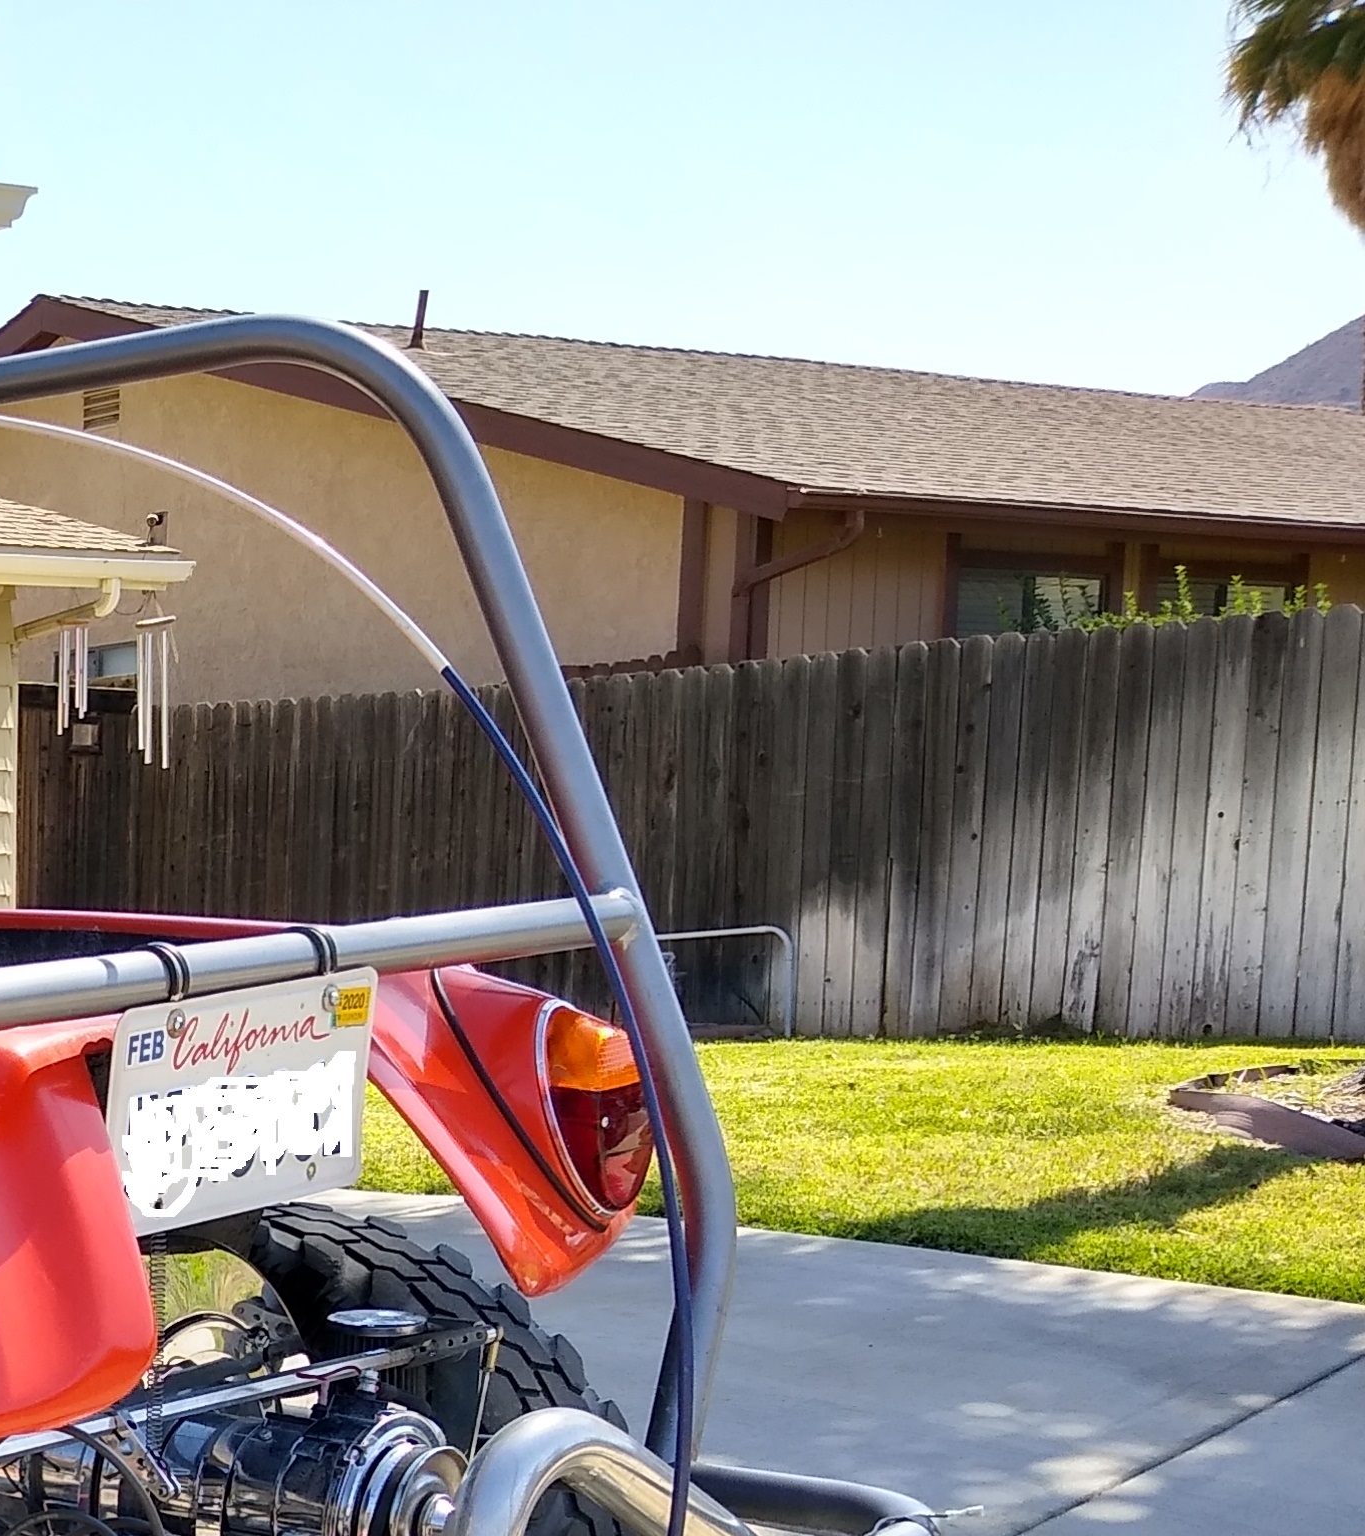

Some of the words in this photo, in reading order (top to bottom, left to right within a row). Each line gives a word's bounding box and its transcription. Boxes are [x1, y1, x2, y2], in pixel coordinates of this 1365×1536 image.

[341, 992, 366, 1011] 2020
[127, 1031, 164, 1065] FEB
[174, 1008, 329, 1074] California
